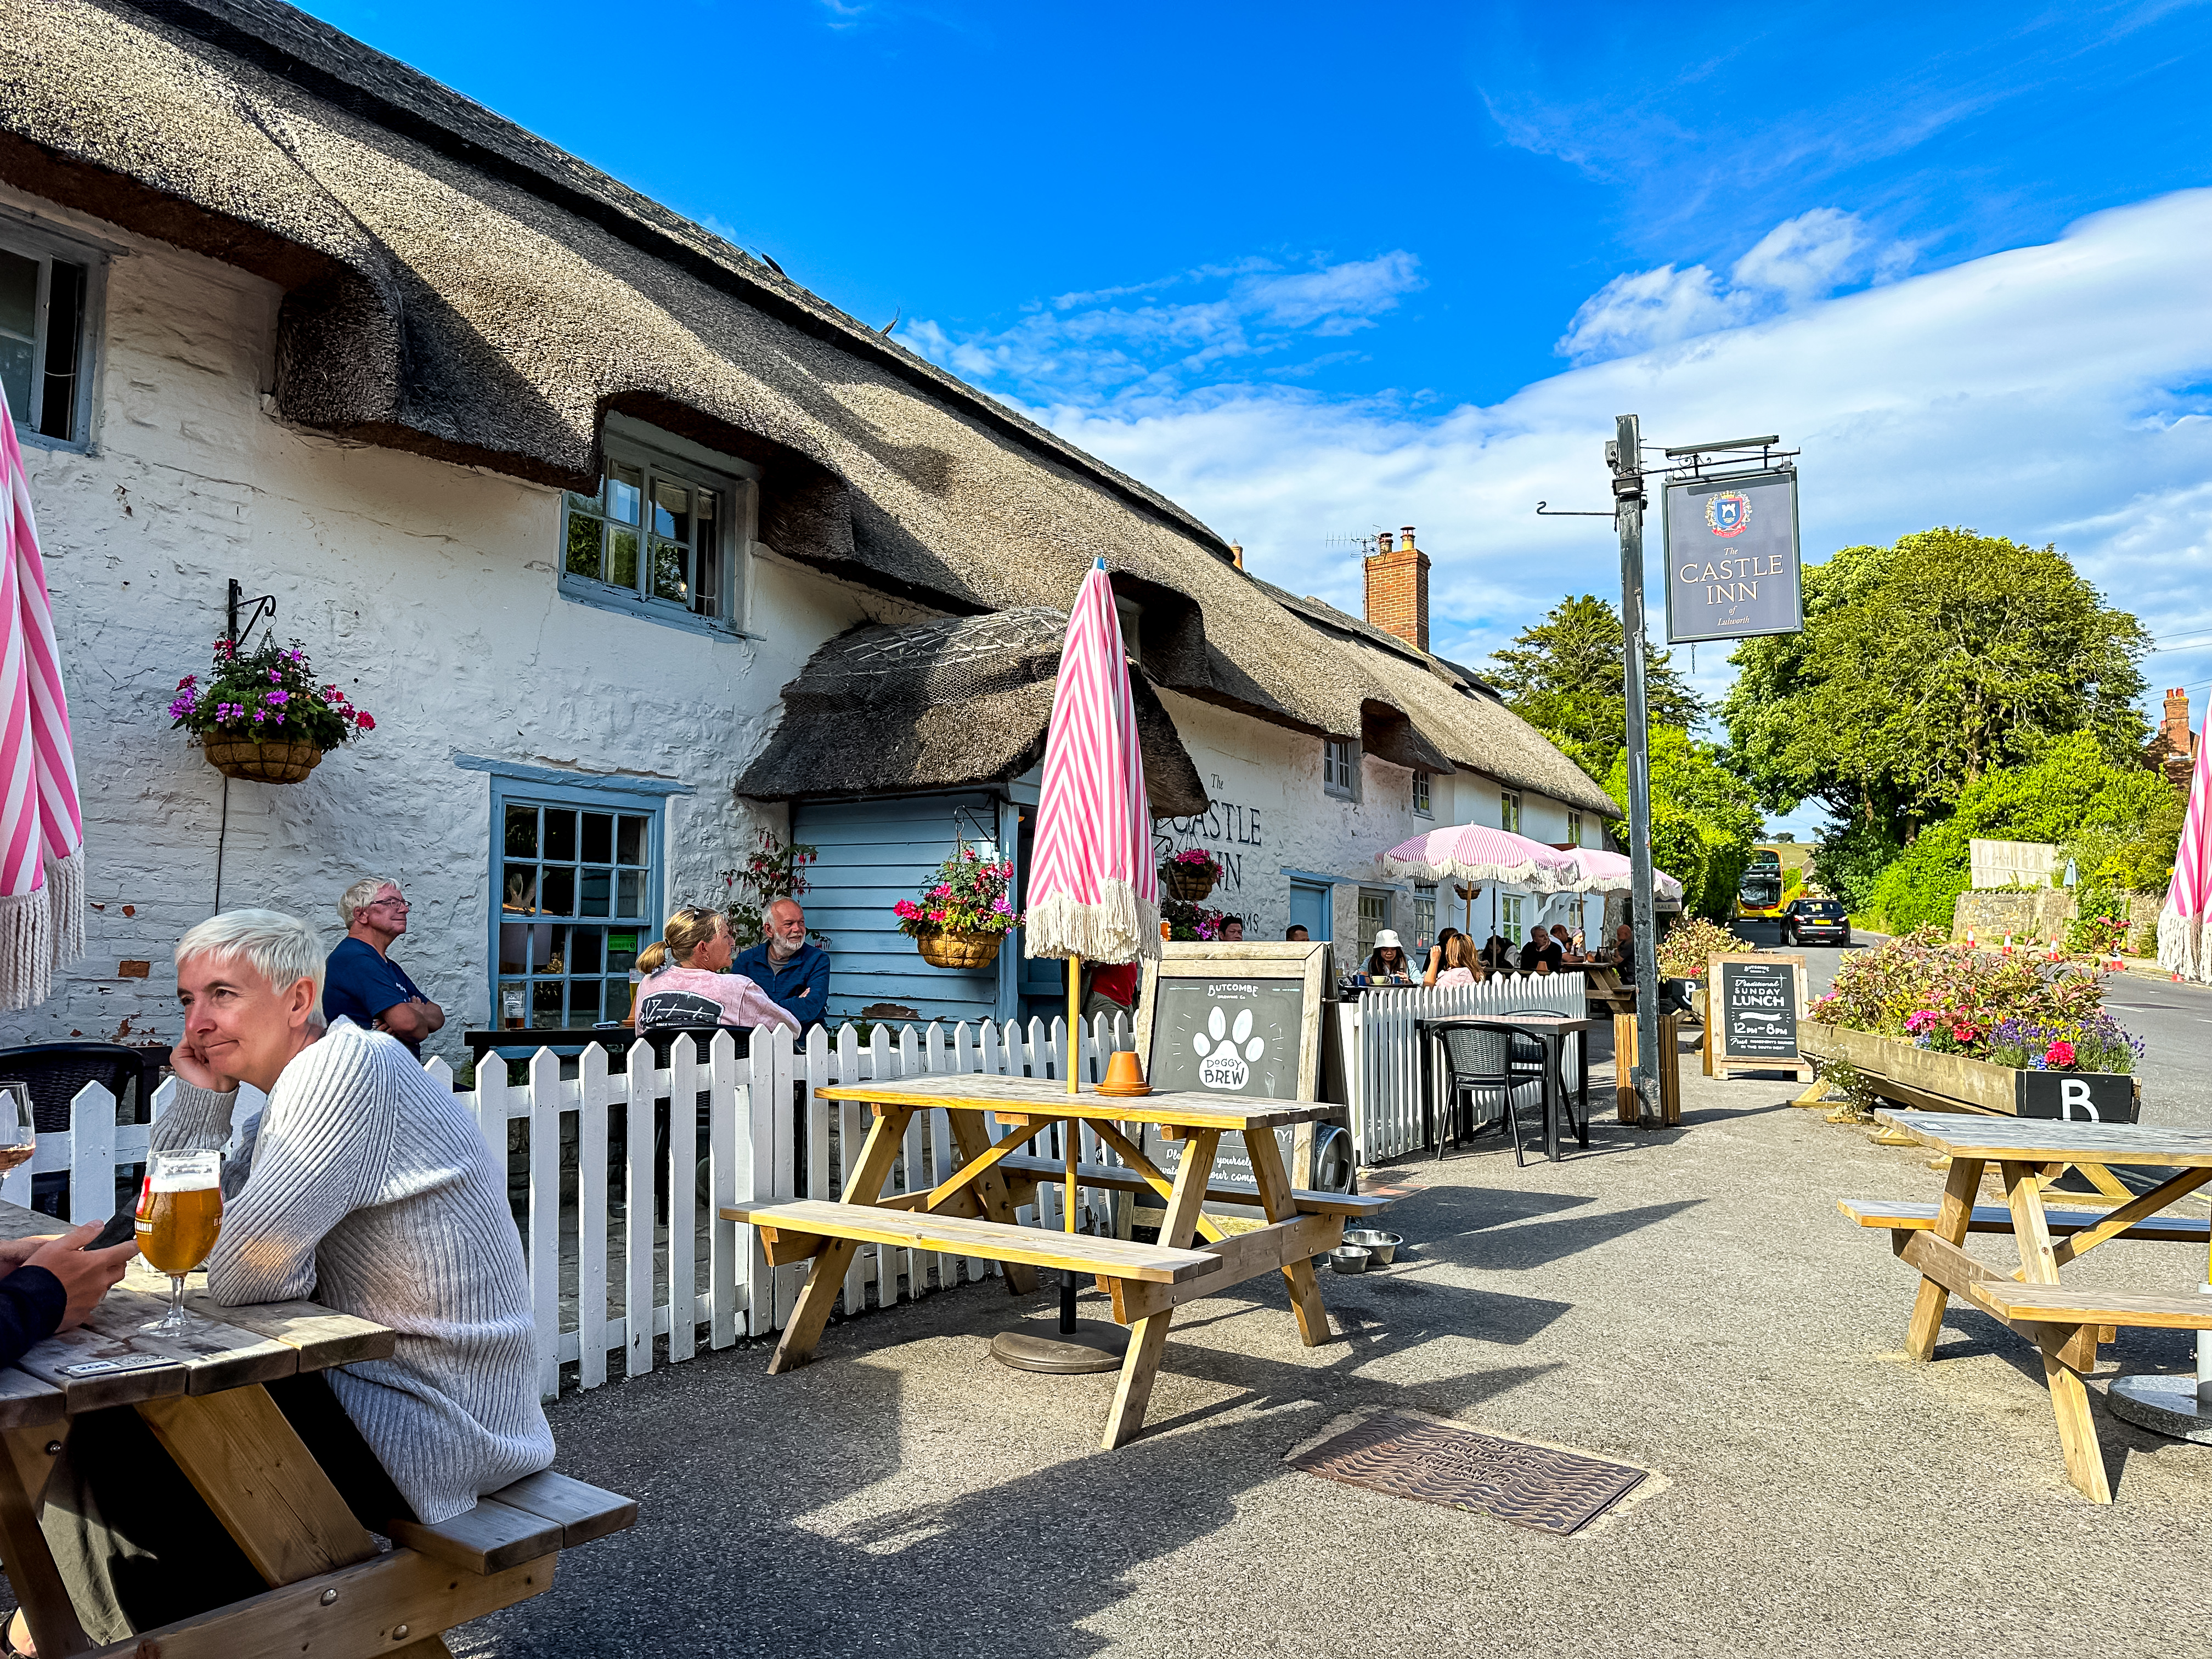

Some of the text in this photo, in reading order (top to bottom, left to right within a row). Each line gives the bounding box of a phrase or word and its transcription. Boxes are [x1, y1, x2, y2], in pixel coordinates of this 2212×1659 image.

[1723, 548, 1739, 556] The
[1679, 554, 1784, 583] CASTLE
[1706, 580, 1758, 605] INN
[1729, 606, 1737, 615] of
[1717, 615, 1750, 626] Lulworth
[1210, 773, 1224, 790] The
[1207, 984, 1259, 997] BUTCOMBE
[1735, 987, 1780, 995] SUNDAY
[1732, 995, 1785, 1007] LUNCH
[1204, 1067, 1245, 1085] BREW
